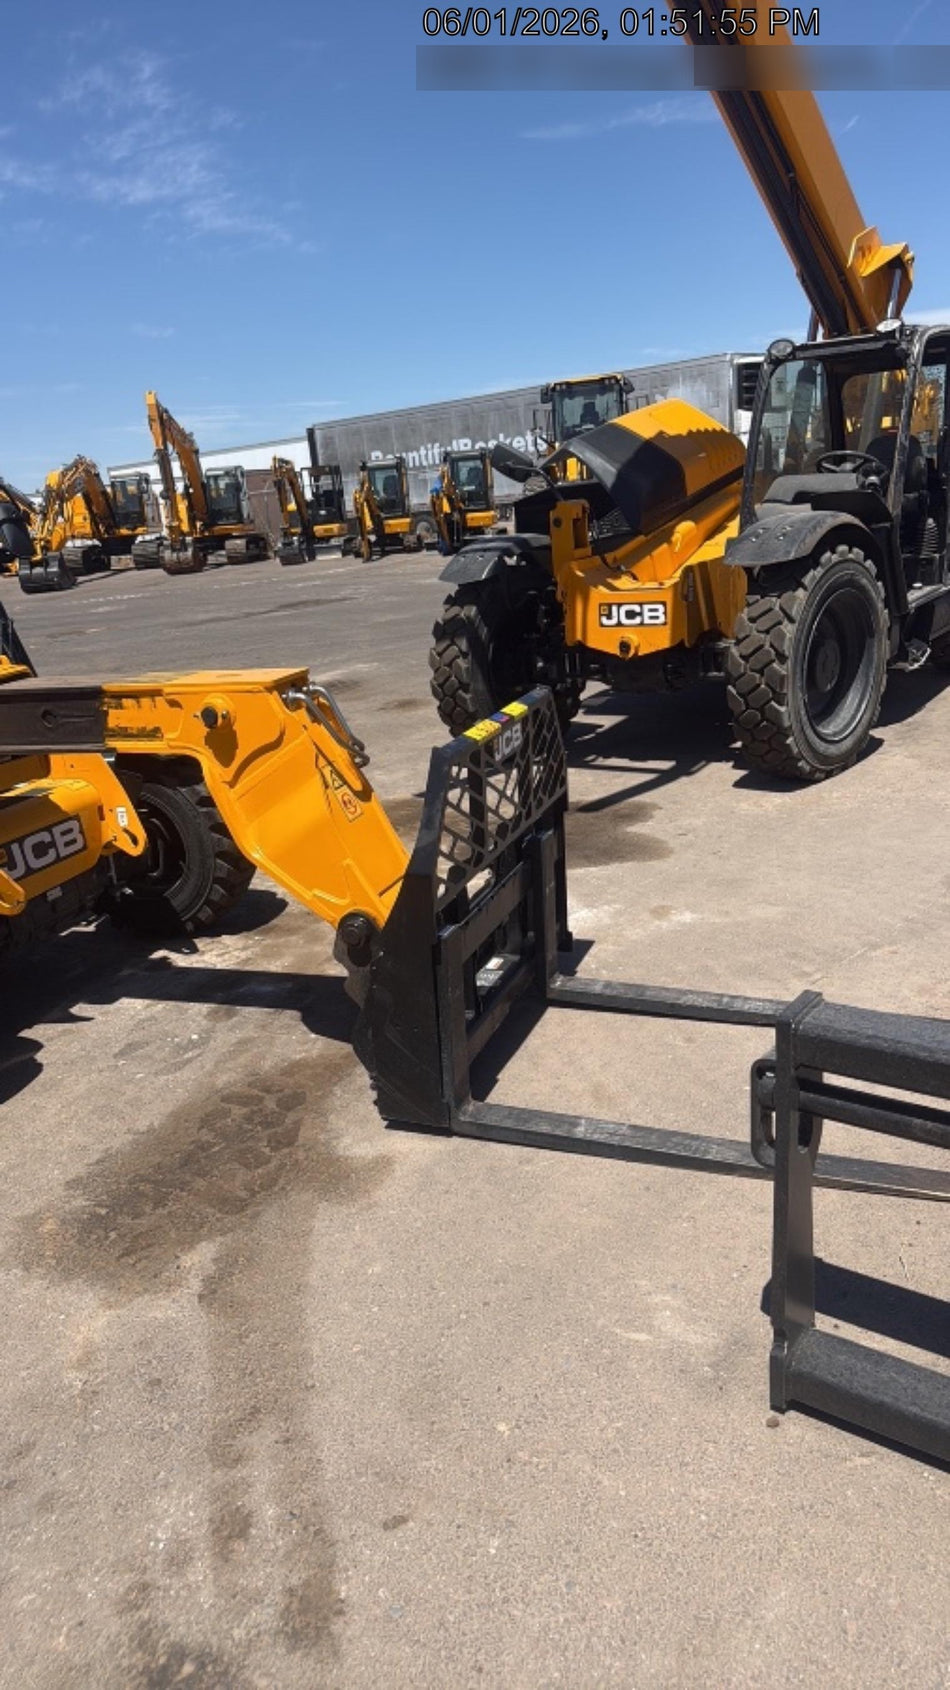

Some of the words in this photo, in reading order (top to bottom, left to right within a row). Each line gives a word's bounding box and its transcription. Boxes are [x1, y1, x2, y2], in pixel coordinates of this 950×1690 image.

[600, 604, 665, 625] JCB
[495, 723, 521, 761] JCB
[5, 820, 85, 879] JCB
